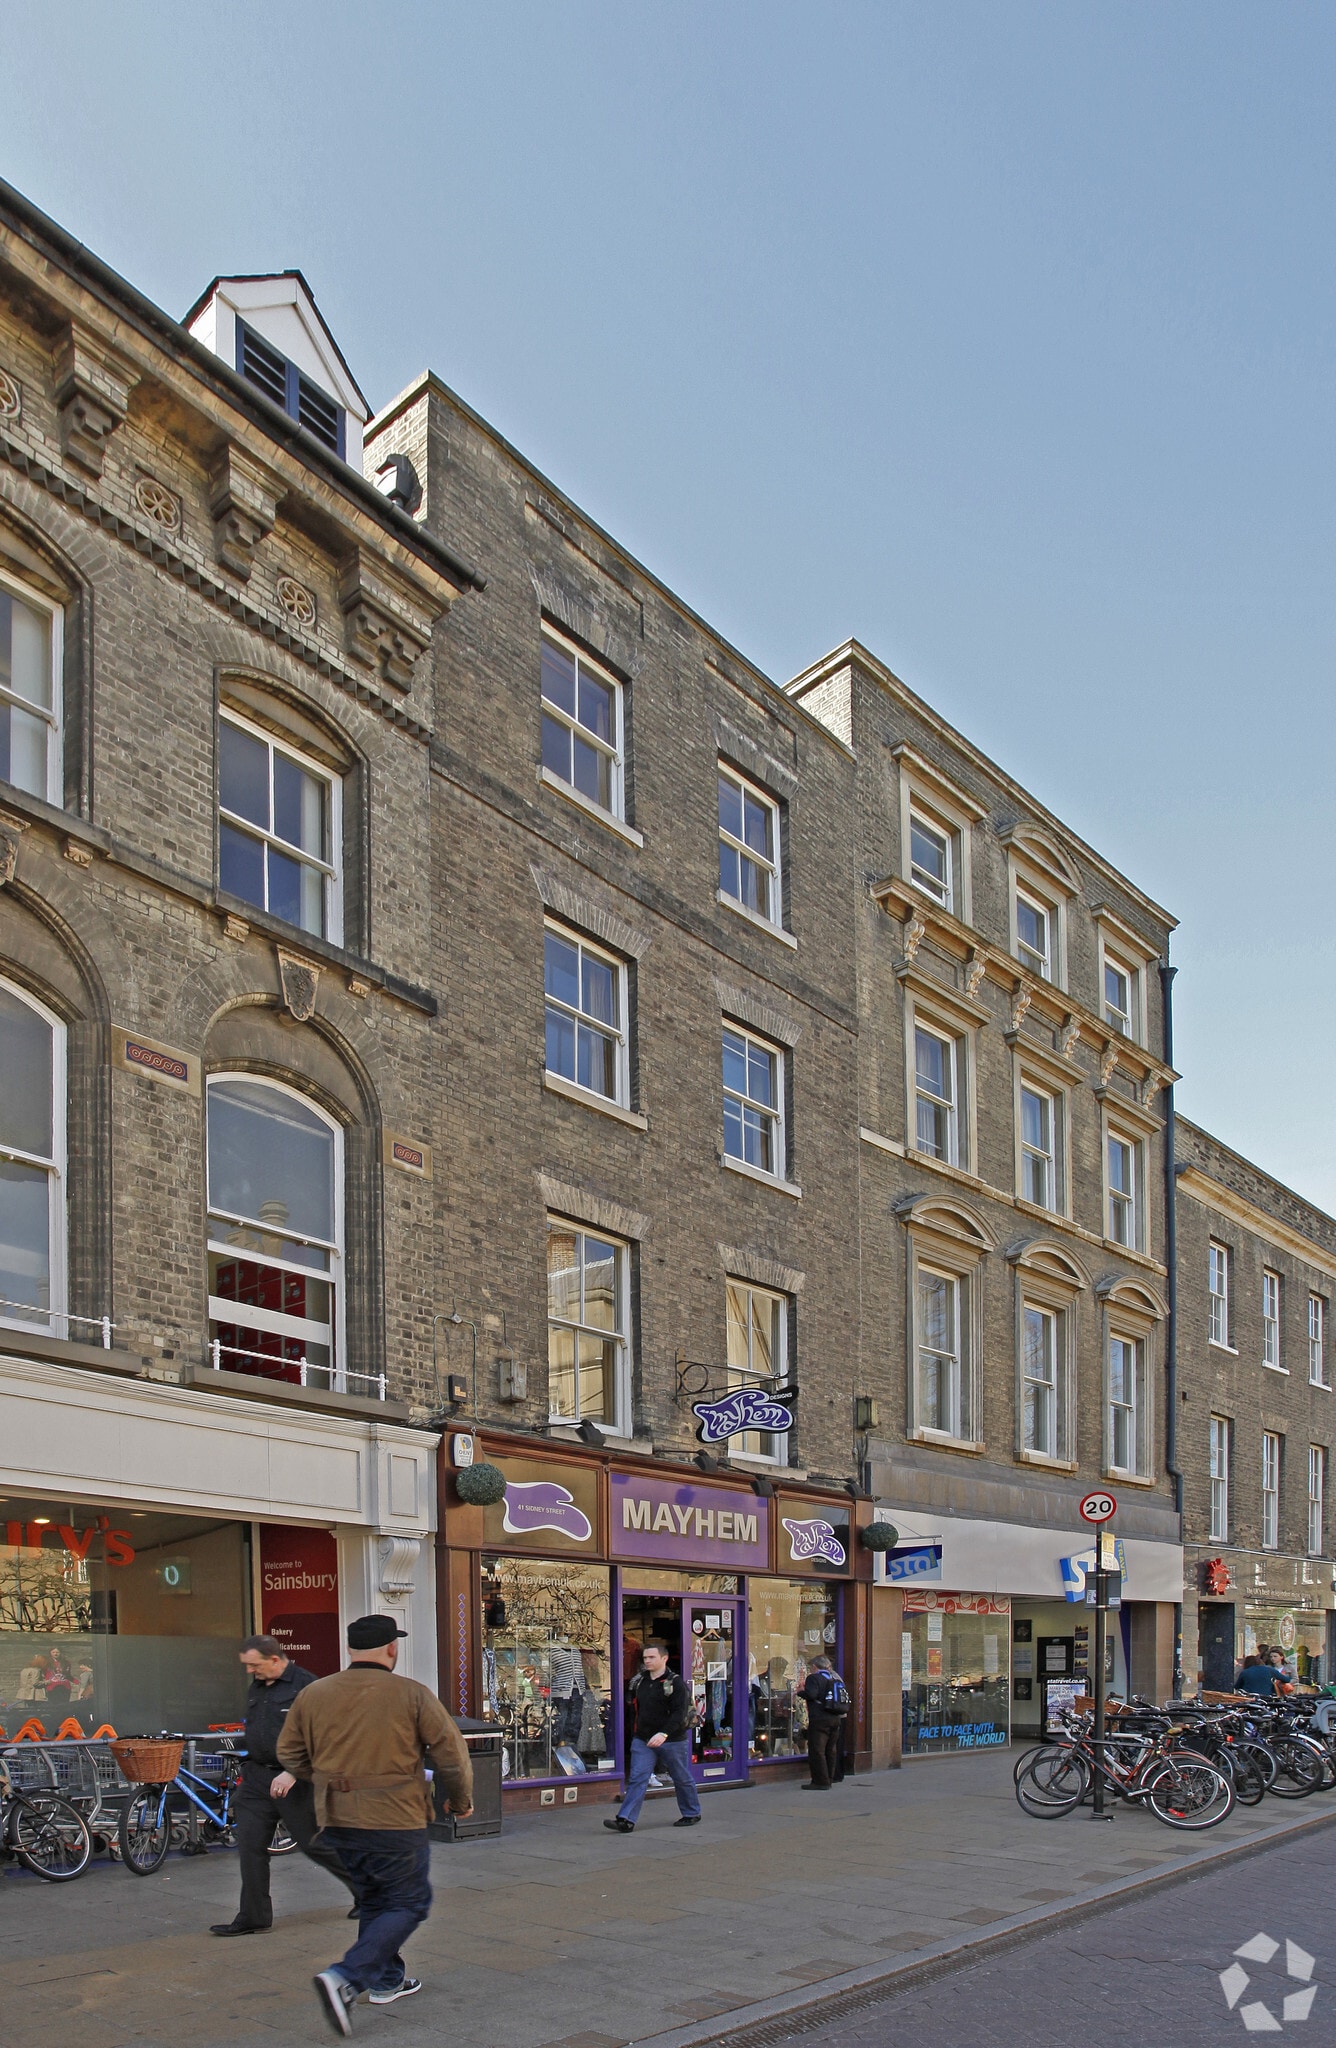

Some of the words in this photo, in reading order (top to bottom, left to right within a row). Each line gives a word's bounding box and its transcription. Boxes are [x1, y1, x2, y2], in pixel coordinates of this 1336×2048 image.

[769, 1392, 793, 1400] DESIGNS
[706, 1393, 783, 1436] mayhem
[517, 1503, 525, 1511] 41
[525, 1504, 545, 1514] SIDNEY
[545, 1507, 566, 1515] STREET
[1085, 1500, 1112, 1514] 20
[622, 1497, 758, 1543] MAYHEM
[264, 1561, 293, 1570] Welcome
[294, 1560, 302, 1568] to
[890, 1555, 931, 1577] sta
[1117, 1542, 1127, 1582] TRAVEL
[264, 1571, 337, 1592] Sainsbury
[487, 1572, 601, 1590] www.mayhemuk.co.uk
[271, 1628, 293, 1637] Bakery
[280, 1643, 311, 1651] licatessen
[918, 1725, 938, 1739] FACE
[941, 1725, 952, 1738] TO
[952, 1724, 973, 1736] FACE
[974, 1722, 994, 1734] WITH
[958, 1734, 975, 1748] THE
[975, 1732, 1006, 1745] WORLD
